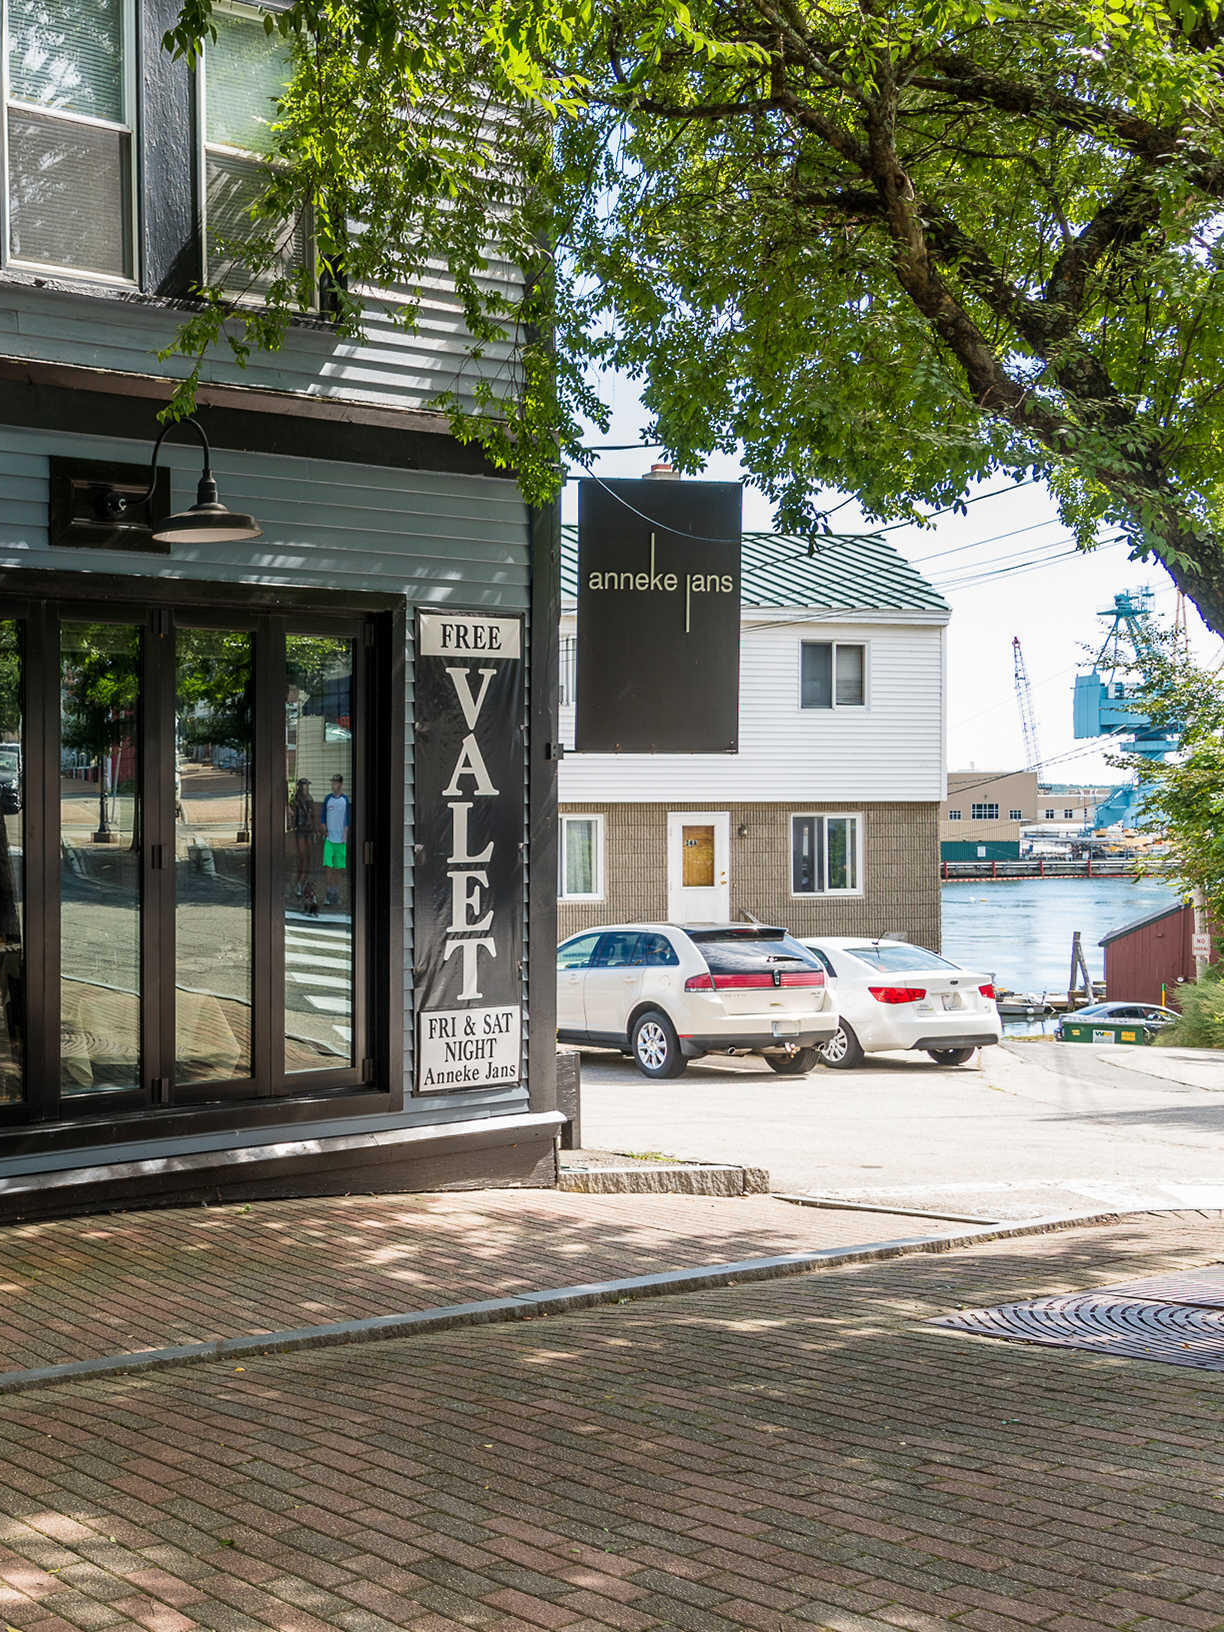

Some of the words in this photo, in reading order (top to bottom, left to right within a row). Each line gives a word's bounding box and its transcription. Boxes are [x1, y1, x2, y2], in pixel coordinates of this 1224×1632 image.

[588, 532, 678, 591] anneke
[685, 574, 734, 633] jans
[440, 623, 502, 650] FREE
[442, 667, 500, 1000] VALET
[428, 1016, 457, 1040] FRI
[463, 1015, 476, 1036] &
[483, 1012, 513, 1035] SAT
[444, 1038, 497, 1063] NIGHT
[423, 1065, 480, 1086] Anneke
[485, 1062, 516, 1080] Jans
